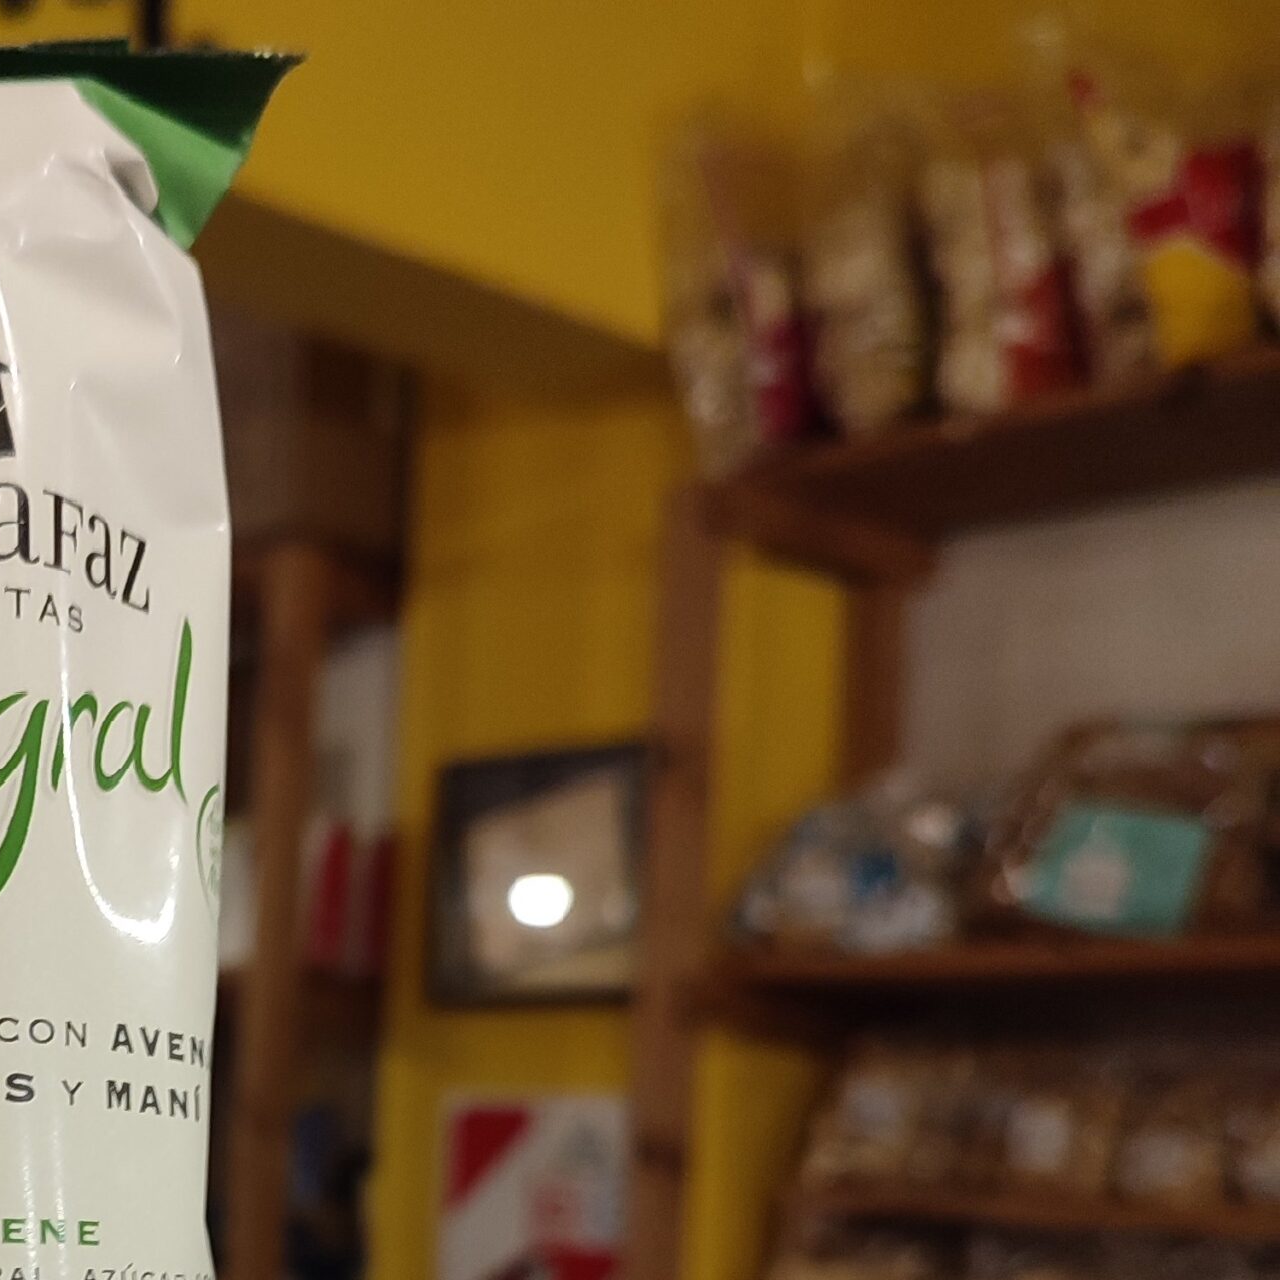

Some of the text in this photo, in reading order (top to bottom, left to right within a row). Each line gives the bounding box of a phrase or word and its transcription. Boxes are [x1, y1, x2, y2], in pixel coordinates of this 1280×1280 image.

[111, 1023, 209, 1069] AVEN
[62, 1080, 84, 1106] Y
[107, 1080, 201, 1122] MANÍ
